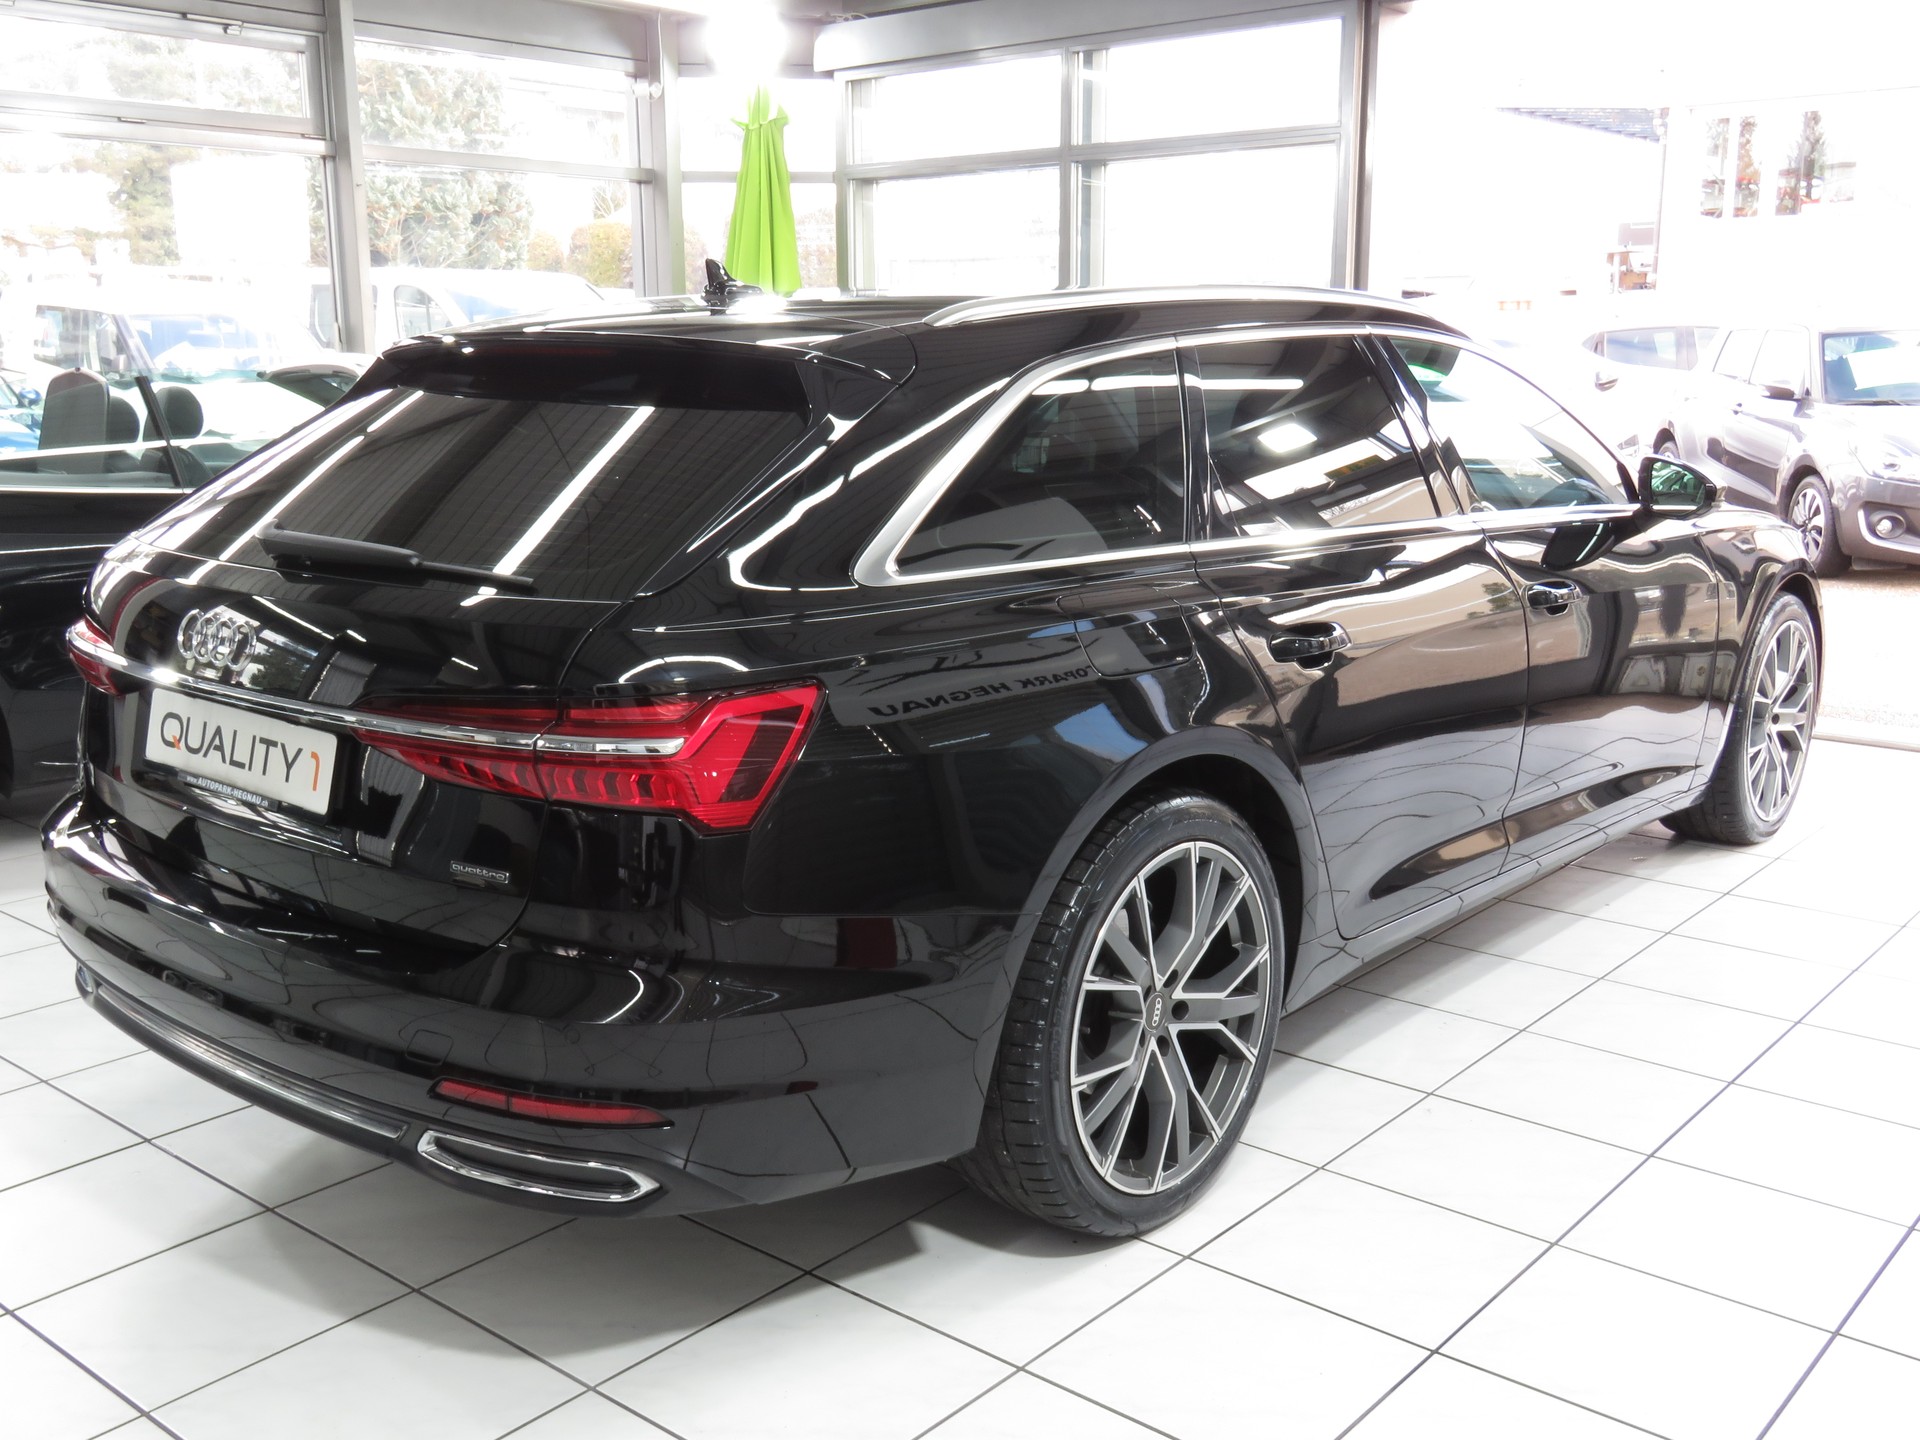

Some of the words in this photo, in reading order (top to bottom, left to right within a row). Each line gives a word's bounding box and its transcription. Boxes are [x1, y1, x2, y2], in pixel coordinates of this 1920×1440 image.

[160, 711, 304, 783] QUALITY
[310, 751, 321, 792] 1
[452, 863, 505, 881] quattro
